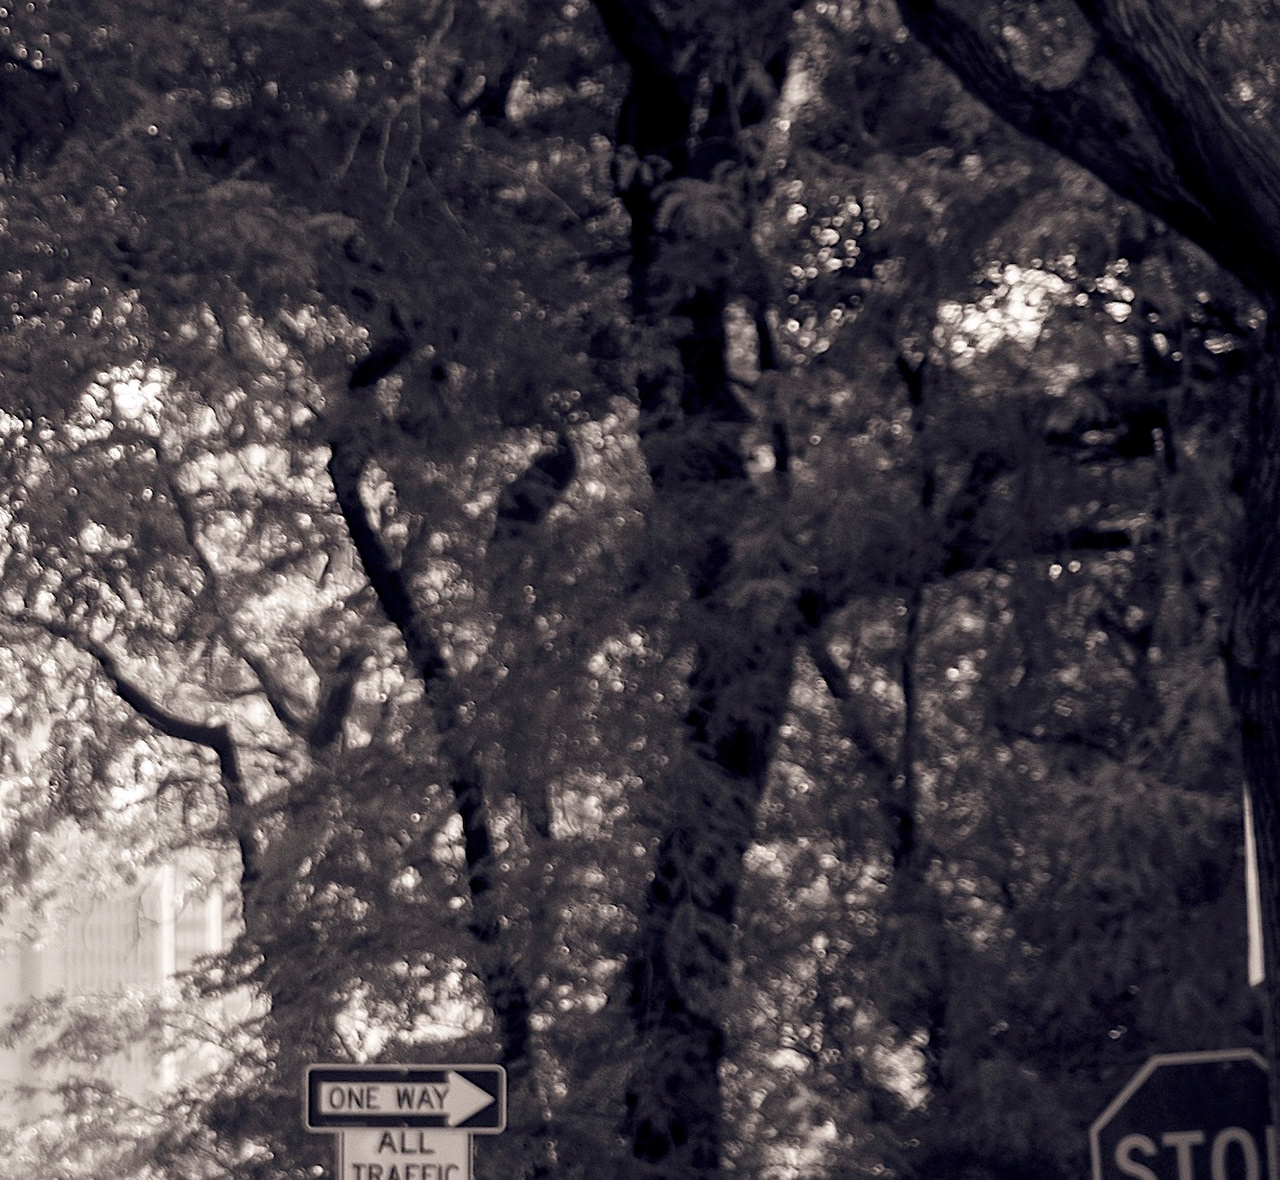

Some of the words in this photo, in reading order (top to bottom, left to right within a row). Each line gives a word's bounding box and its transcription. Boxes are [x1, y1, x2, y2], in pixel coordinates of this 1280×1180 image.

[329, 1087, 381, 1109] ONE
[396, 1087, 450, 1110] WAY
[378, 1132, 435, 1154] ALL
